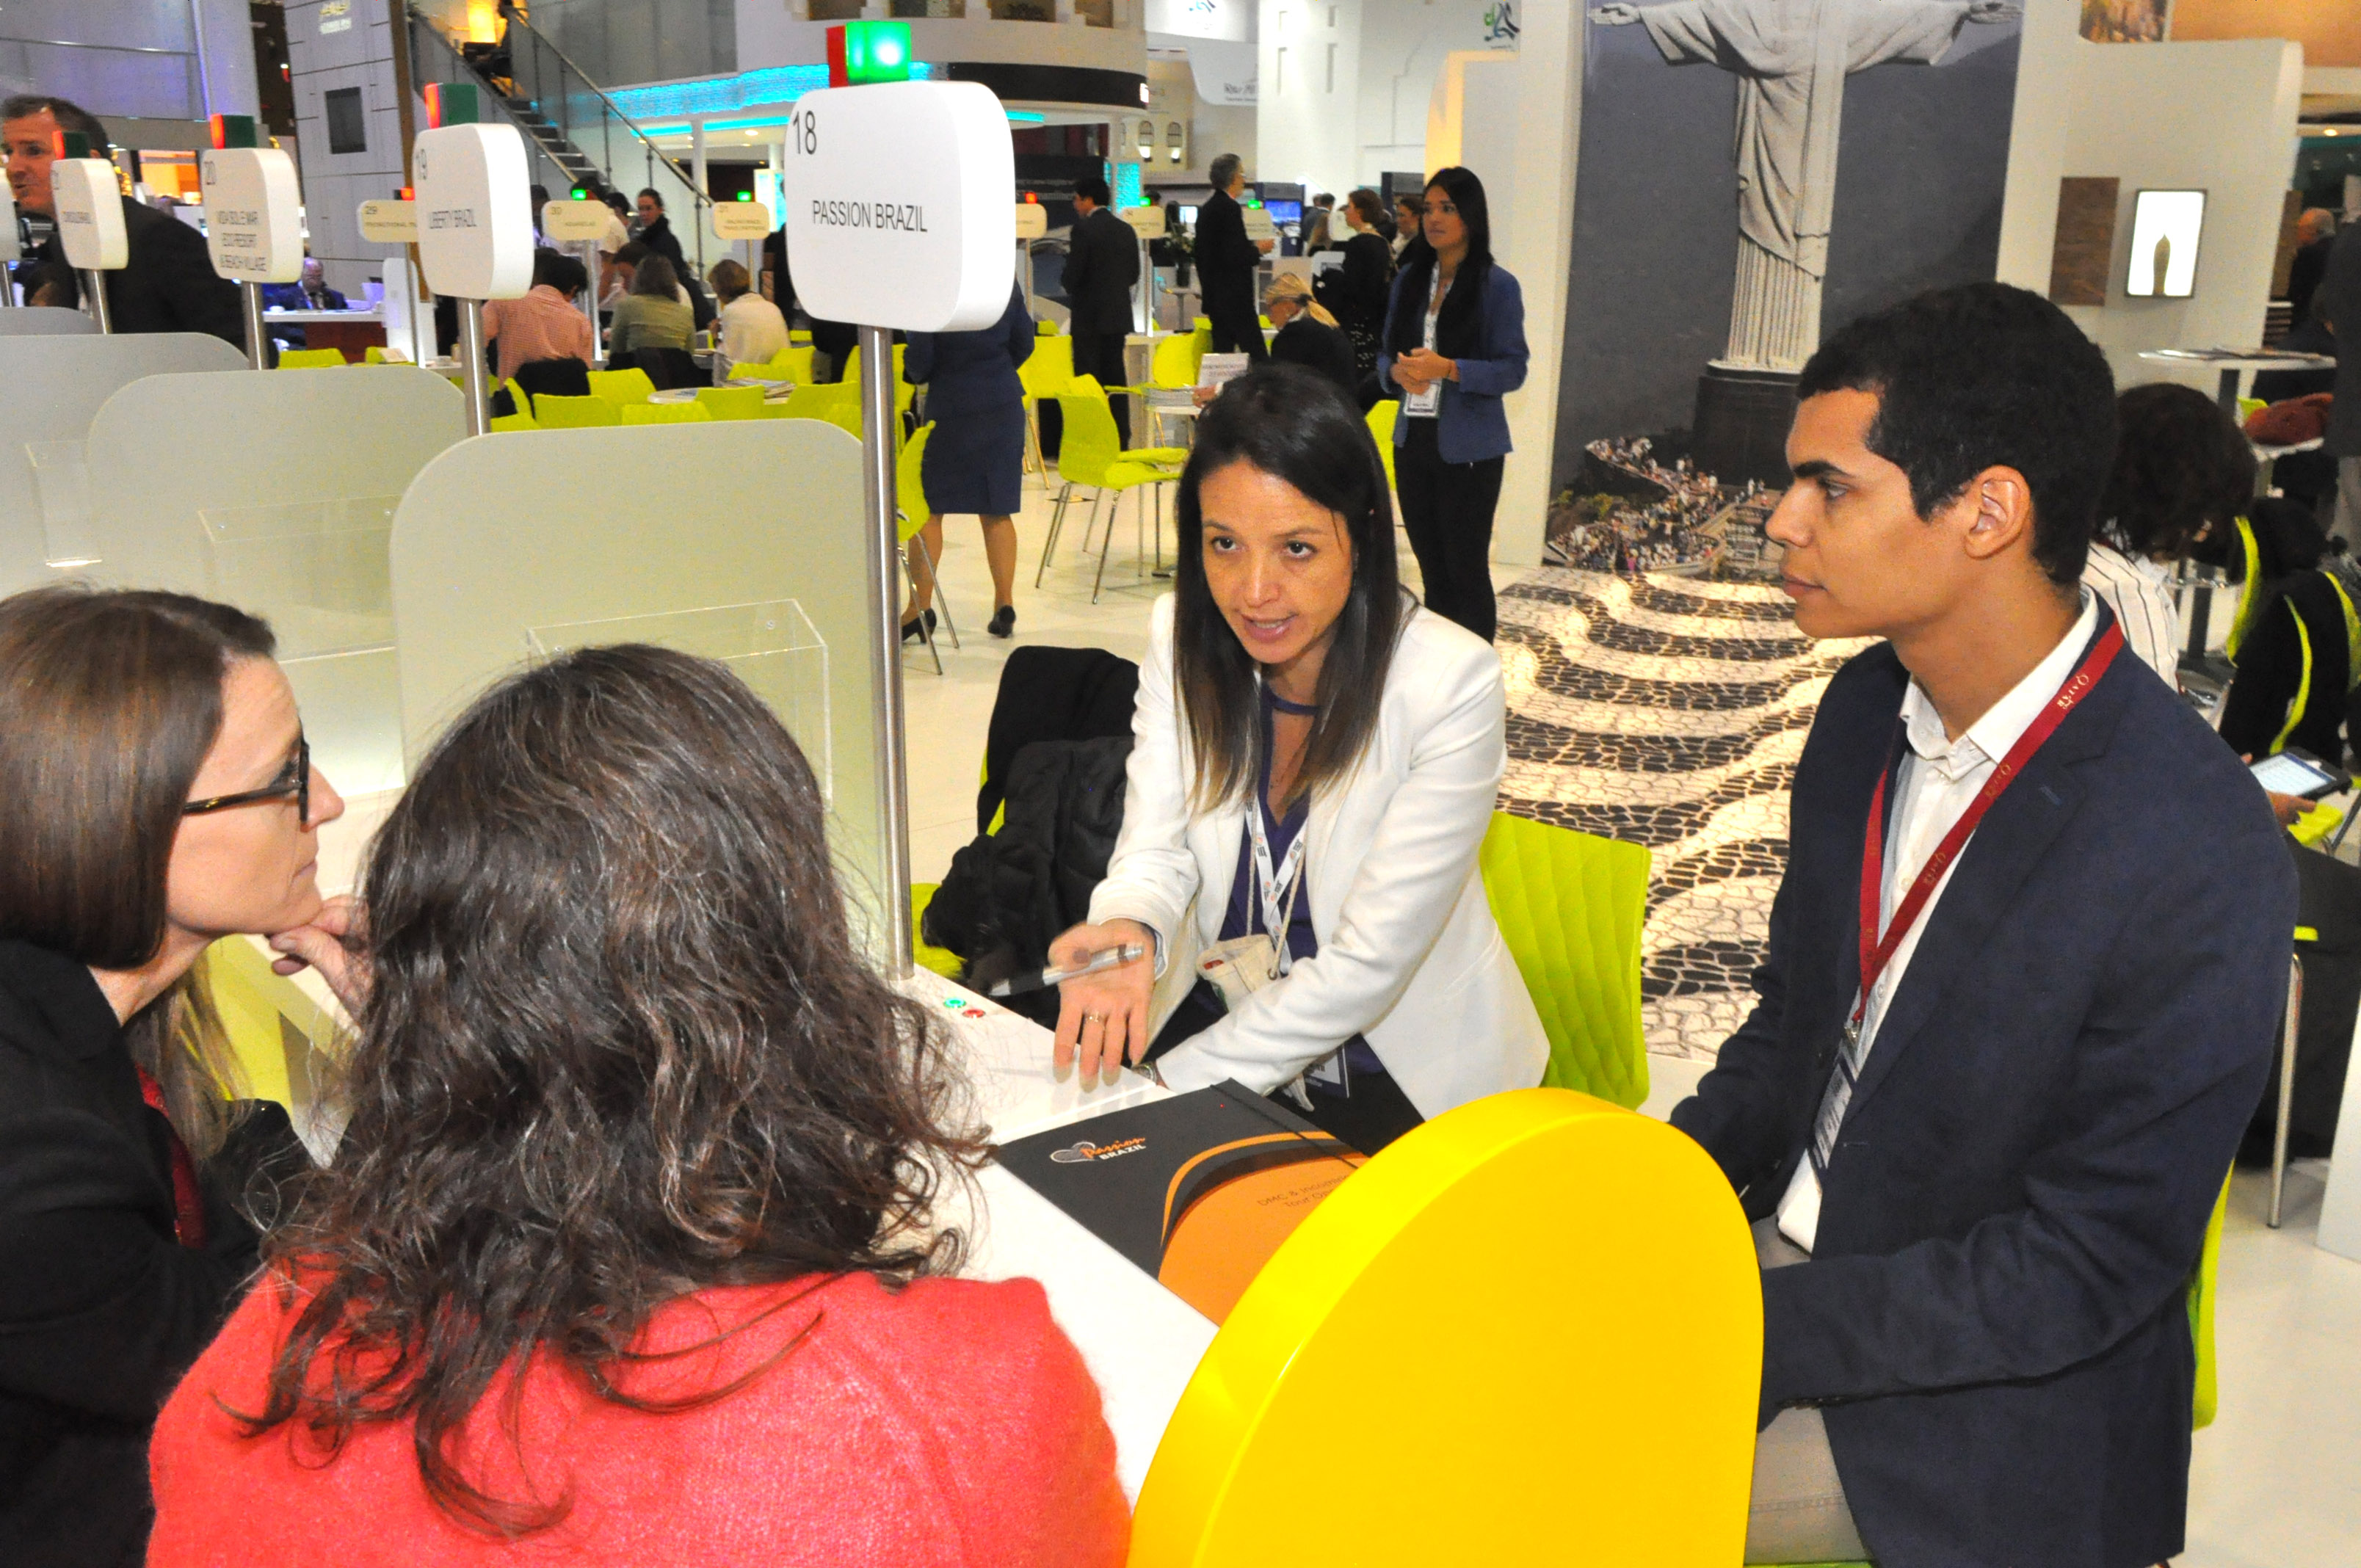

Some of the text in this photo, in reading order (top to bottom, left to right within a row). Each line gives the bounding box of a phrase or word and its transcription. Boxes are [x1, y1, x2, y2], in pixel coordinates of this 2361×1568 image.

[792, 110, 817, 155] 18
[454, 208, 477, 228] BRAZIL
[813, 200, 928, 233] PASSION BRAZIL
[2057, 673, 2089, 708] QATAR
[1098, 1144, 1147, 1161] BRAZIL
[1257, 1193, 1288, 1206] DMC
